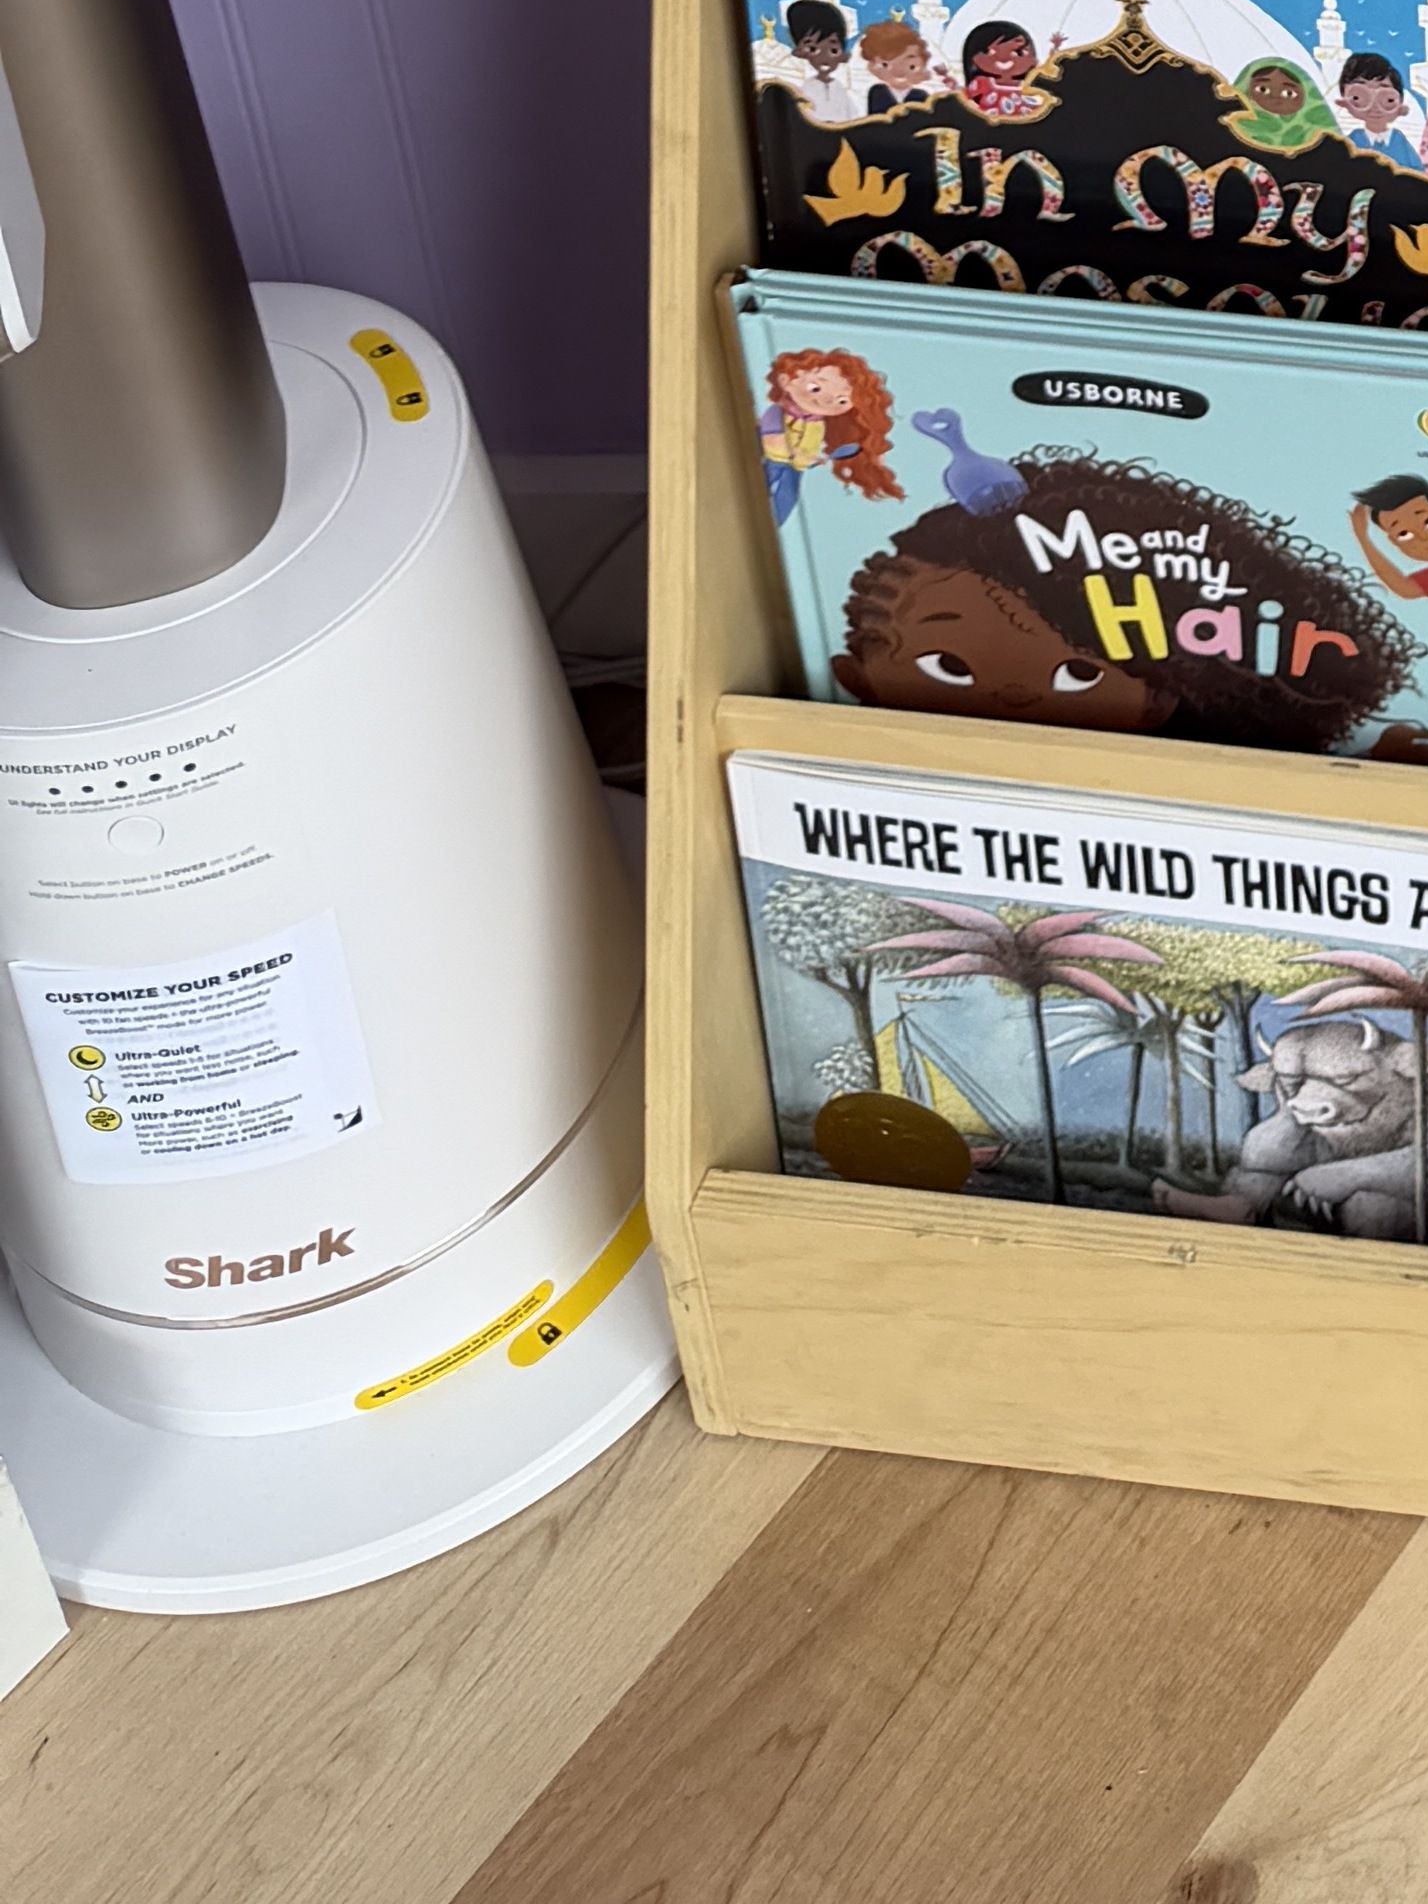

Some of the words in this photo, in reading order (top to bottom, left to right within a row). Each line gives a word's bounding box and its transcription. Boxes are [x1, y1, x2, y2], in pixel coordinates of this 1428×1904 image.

[913, 126, 1076, 223] In
[1111, 144, 1378, 288] My
[1043, 377, 1185, 412] USBORNE
[1012, 508, 1142, 575] Me
[1154, 550, 1248, 600] my
[1084, 573, 1358, 680] Hair
[0, 759, 109, 776] UNDERSTAND
[113, 750, 162, 767] YOUR
[166, 724, 238, 757] DISPLAY
[793, 800, 962, 878] WHERE
[973, 826, 1064, 887] THE
[1080, 837, 1197, 902] WILD
[1211, 853, 1391, 926] THINGS
[45, 986, 160, 1005] CUSTOMIZE
[164, 974, 222, 996] YOUR
[227, 952, 294, 983] SPEED
[115, 1043, 201, 1063] Ultra-Quiet
[164, 1226, 357, 1292] Shark
